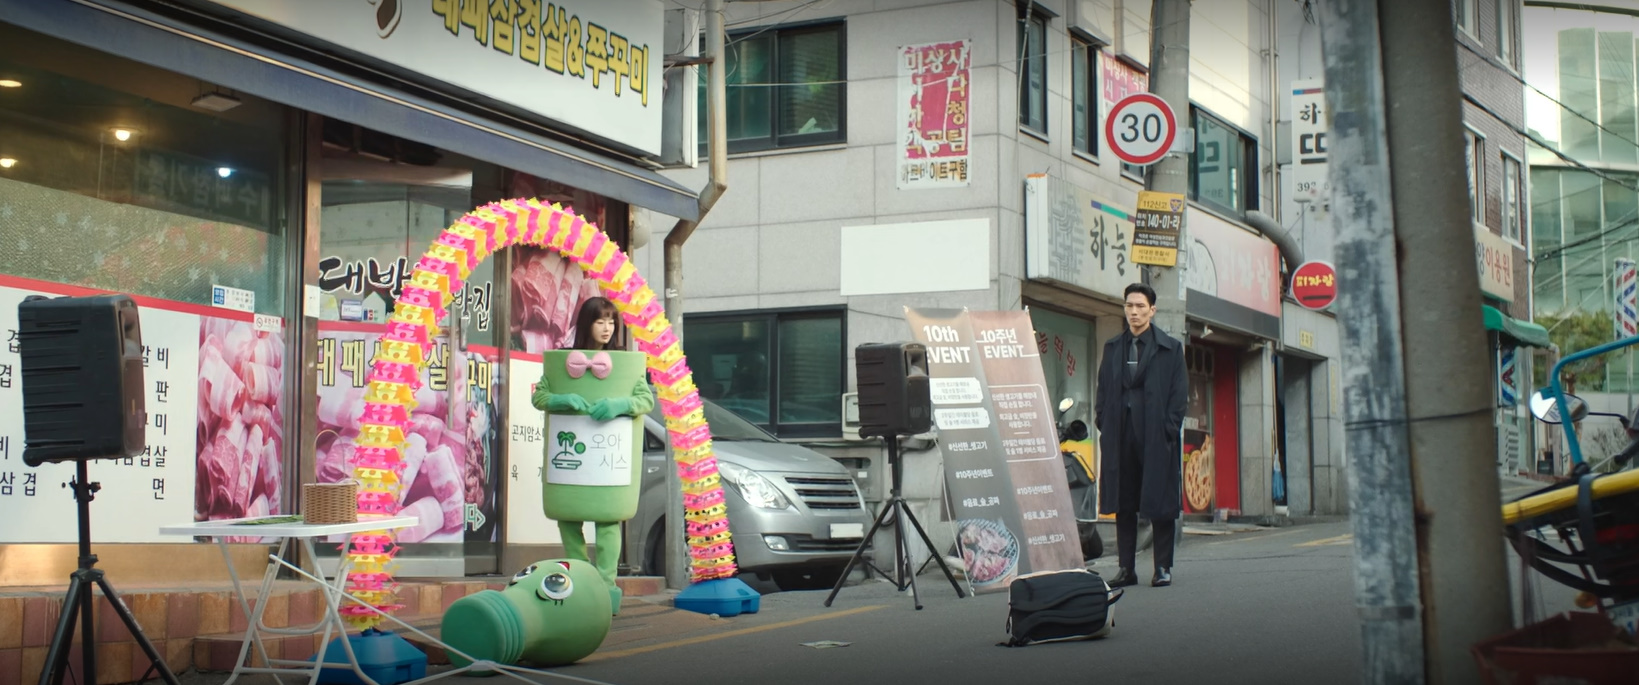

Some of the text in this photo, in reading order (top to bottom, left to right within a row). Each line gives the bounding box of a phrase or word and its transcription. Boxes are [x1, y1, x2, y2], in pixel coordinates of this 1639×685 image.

[1121, 113, 1161, 143] 30
[1144, 200, 1167, 209] 112신고
[1090, 214, 1126, 277] 하늘
[1296, 273, 1335, 287] 피자랑
[923, 325, 959, 343] 10th
[983, 345, 1024, 359] EVENT
[590, 432, 621, 451] 오아
[599, 453, 628, 471] 시스
